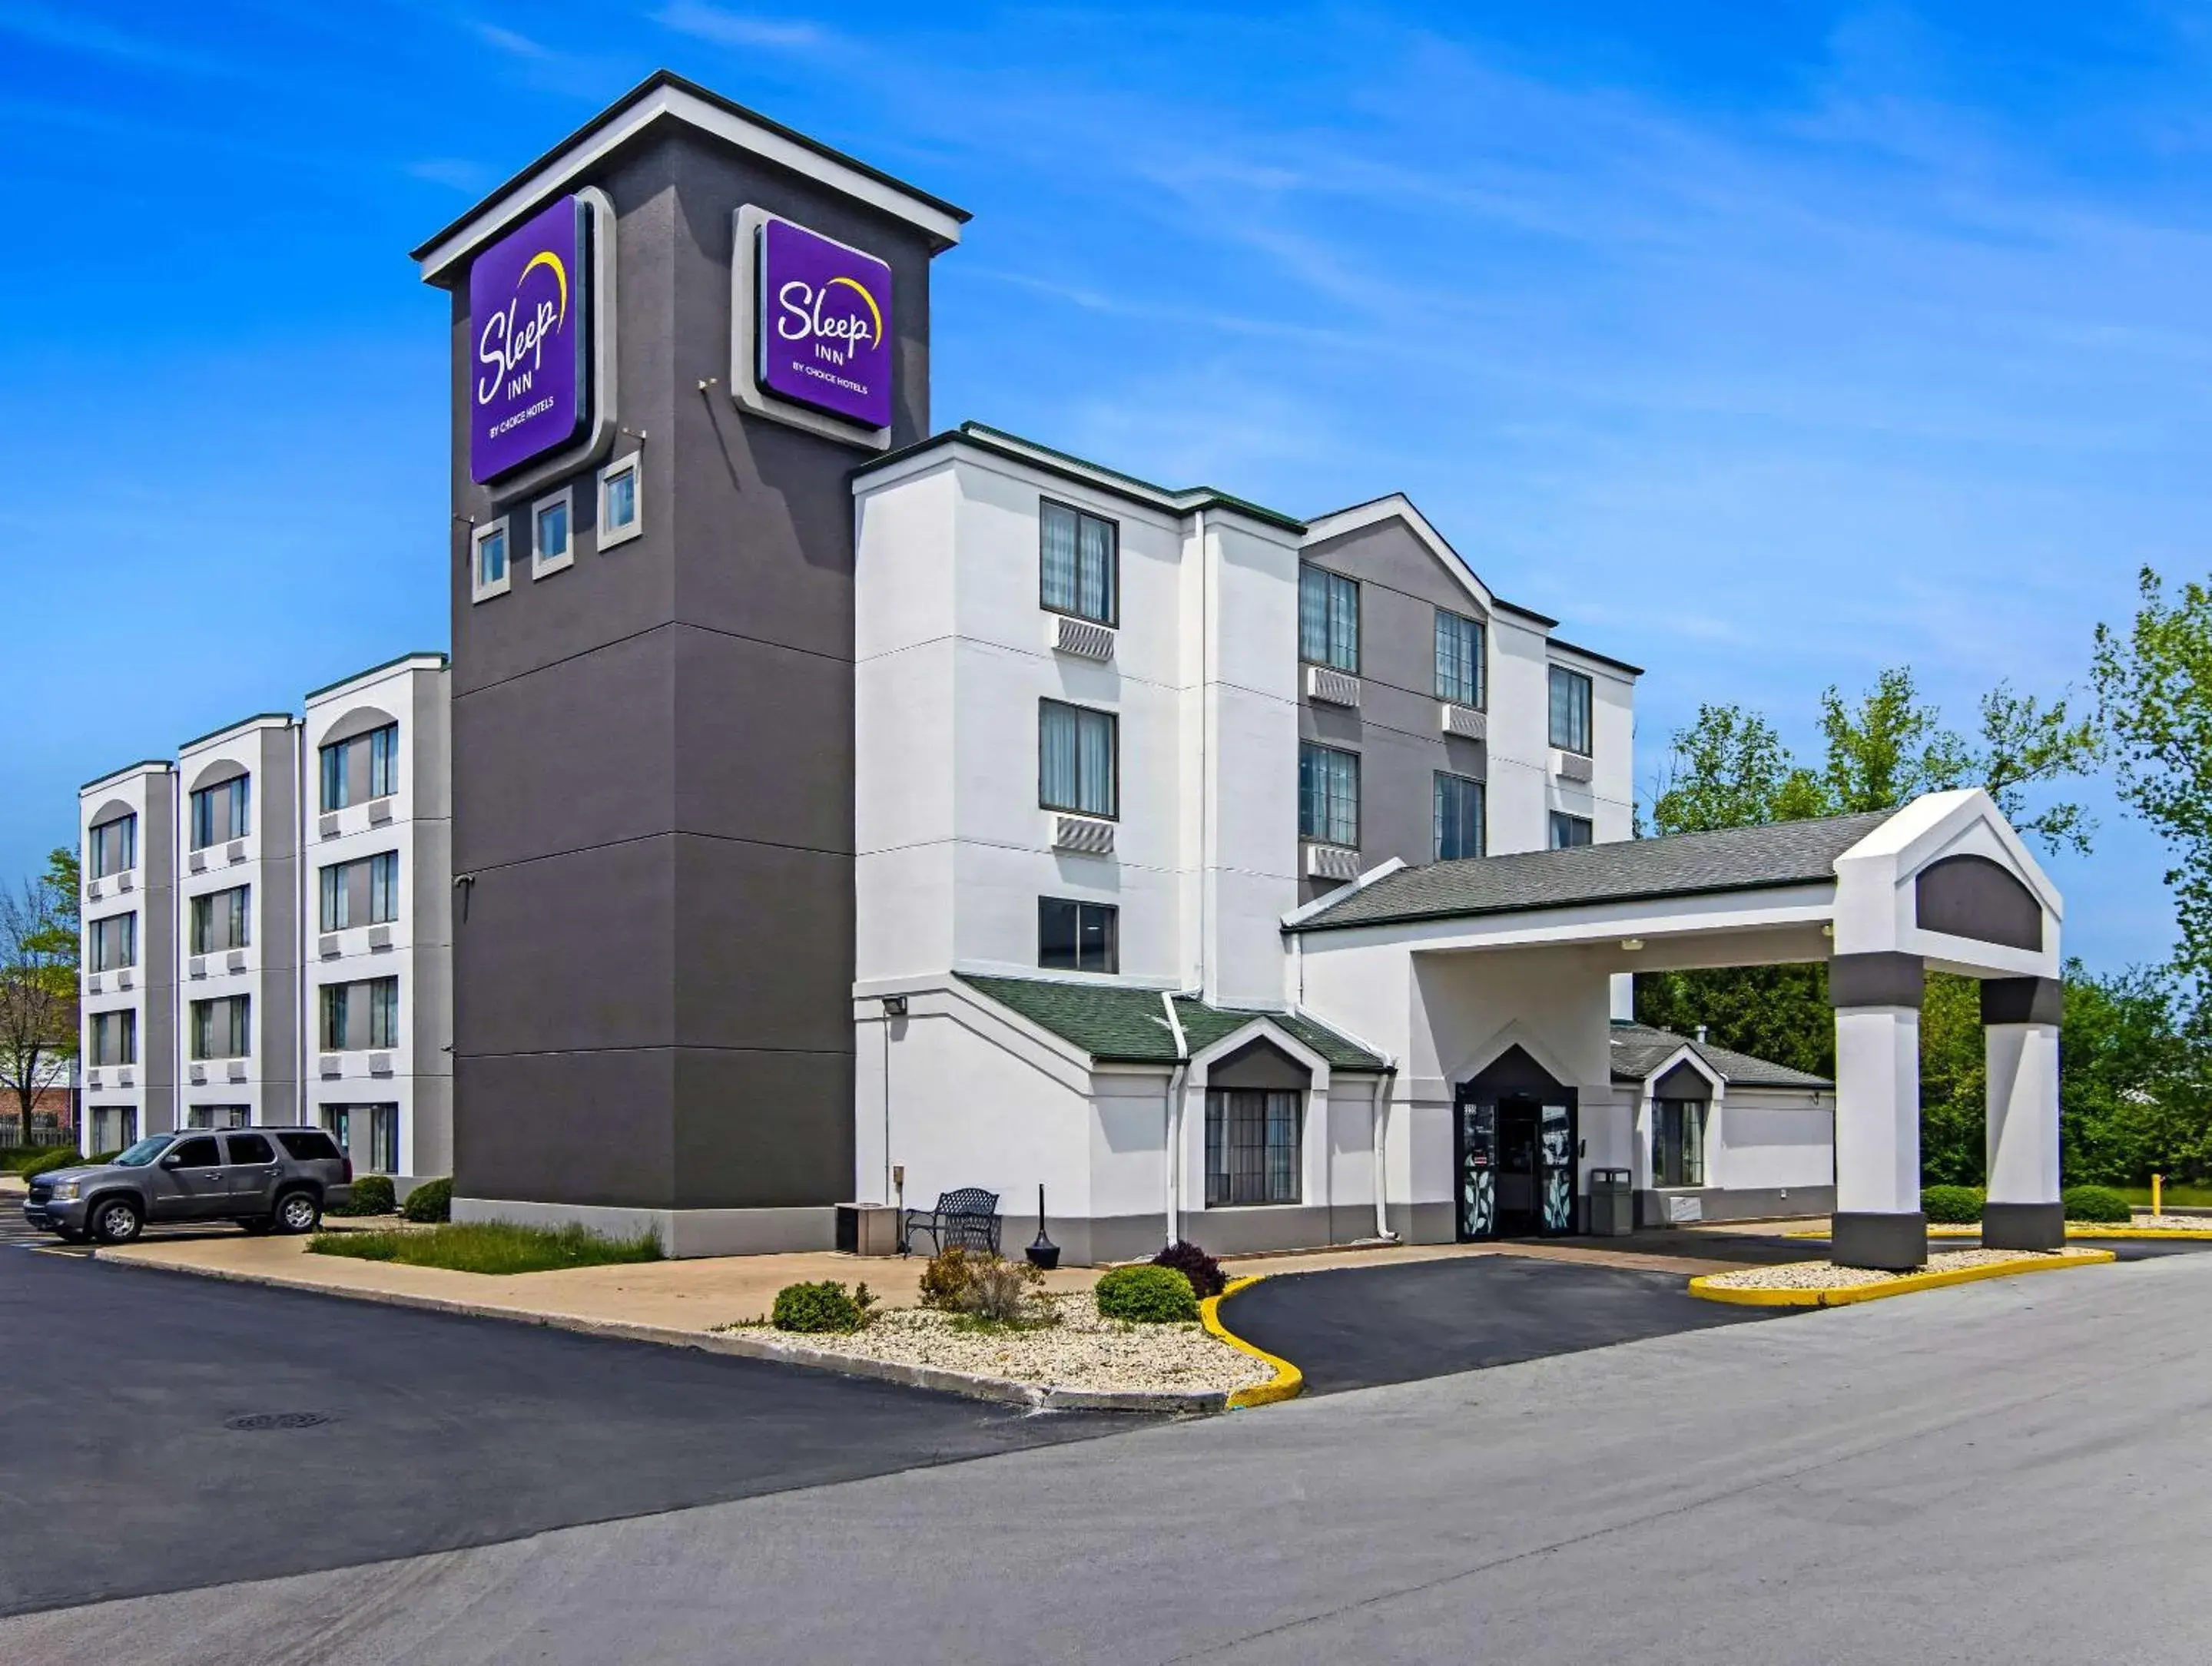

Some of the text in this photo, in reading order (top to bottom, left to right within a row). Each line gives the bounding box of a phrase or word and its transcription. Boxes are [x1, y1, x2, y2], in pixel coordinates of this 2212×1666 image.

[778, 281, 872, 359] Sleep
[479, 298, 557, 405] Sleep
[815, 343, 843, 366] INN
[508, 370, 532, 400] INN
[792, 361, 868, 395] BY CHOICE HOTELS
[489, 396, 554, 439] BY CHOICE HOTELS
